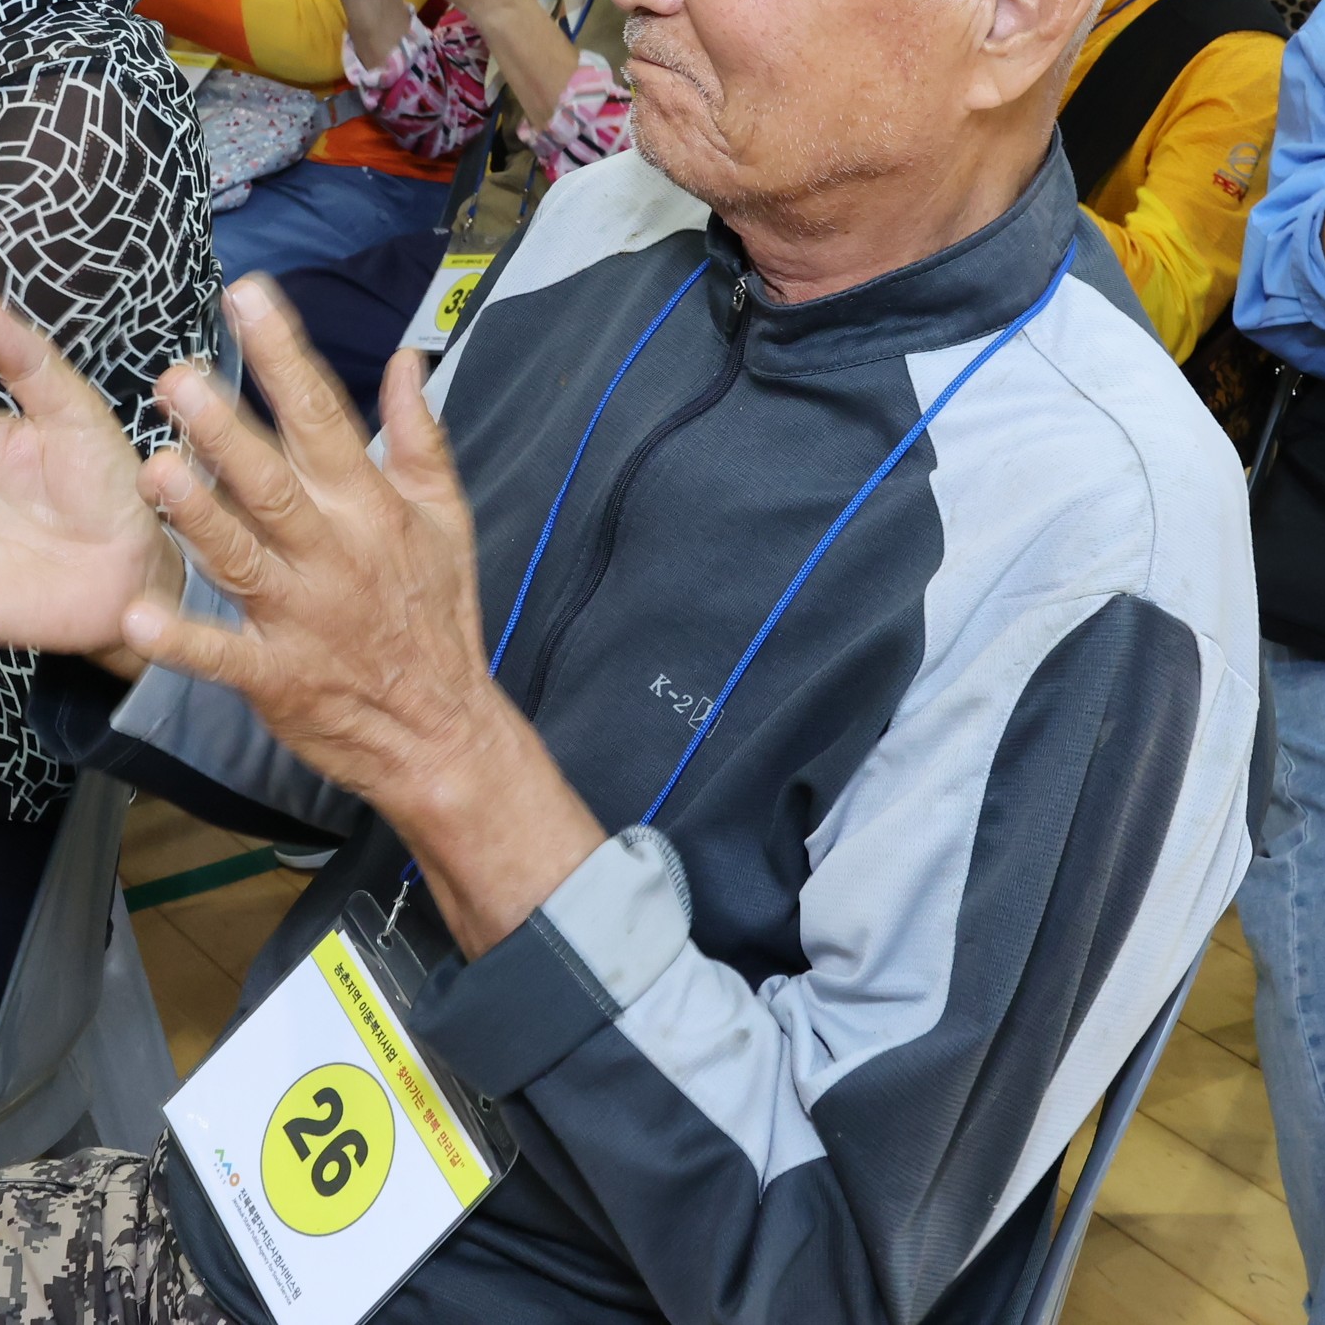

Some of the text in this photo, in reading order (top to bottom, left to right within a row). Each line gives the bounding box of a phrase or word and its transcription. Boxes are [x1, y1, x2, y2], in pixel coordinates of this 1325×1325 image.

[333, 962, 363, 1004] 농촌지역
[358, 1002, 398, 1064] 이동복지사업
[422, 1108, 441, 1134] 행복
[282, 1086, 369, 1198] 26
[238, 1187, 303, 1301] 전북특별자치도사회서비스원
[258, 1245, 269, 1264] Agency
[273, 1271, 283, 1287] Social
[281, 1285, 292, 1306] Service
